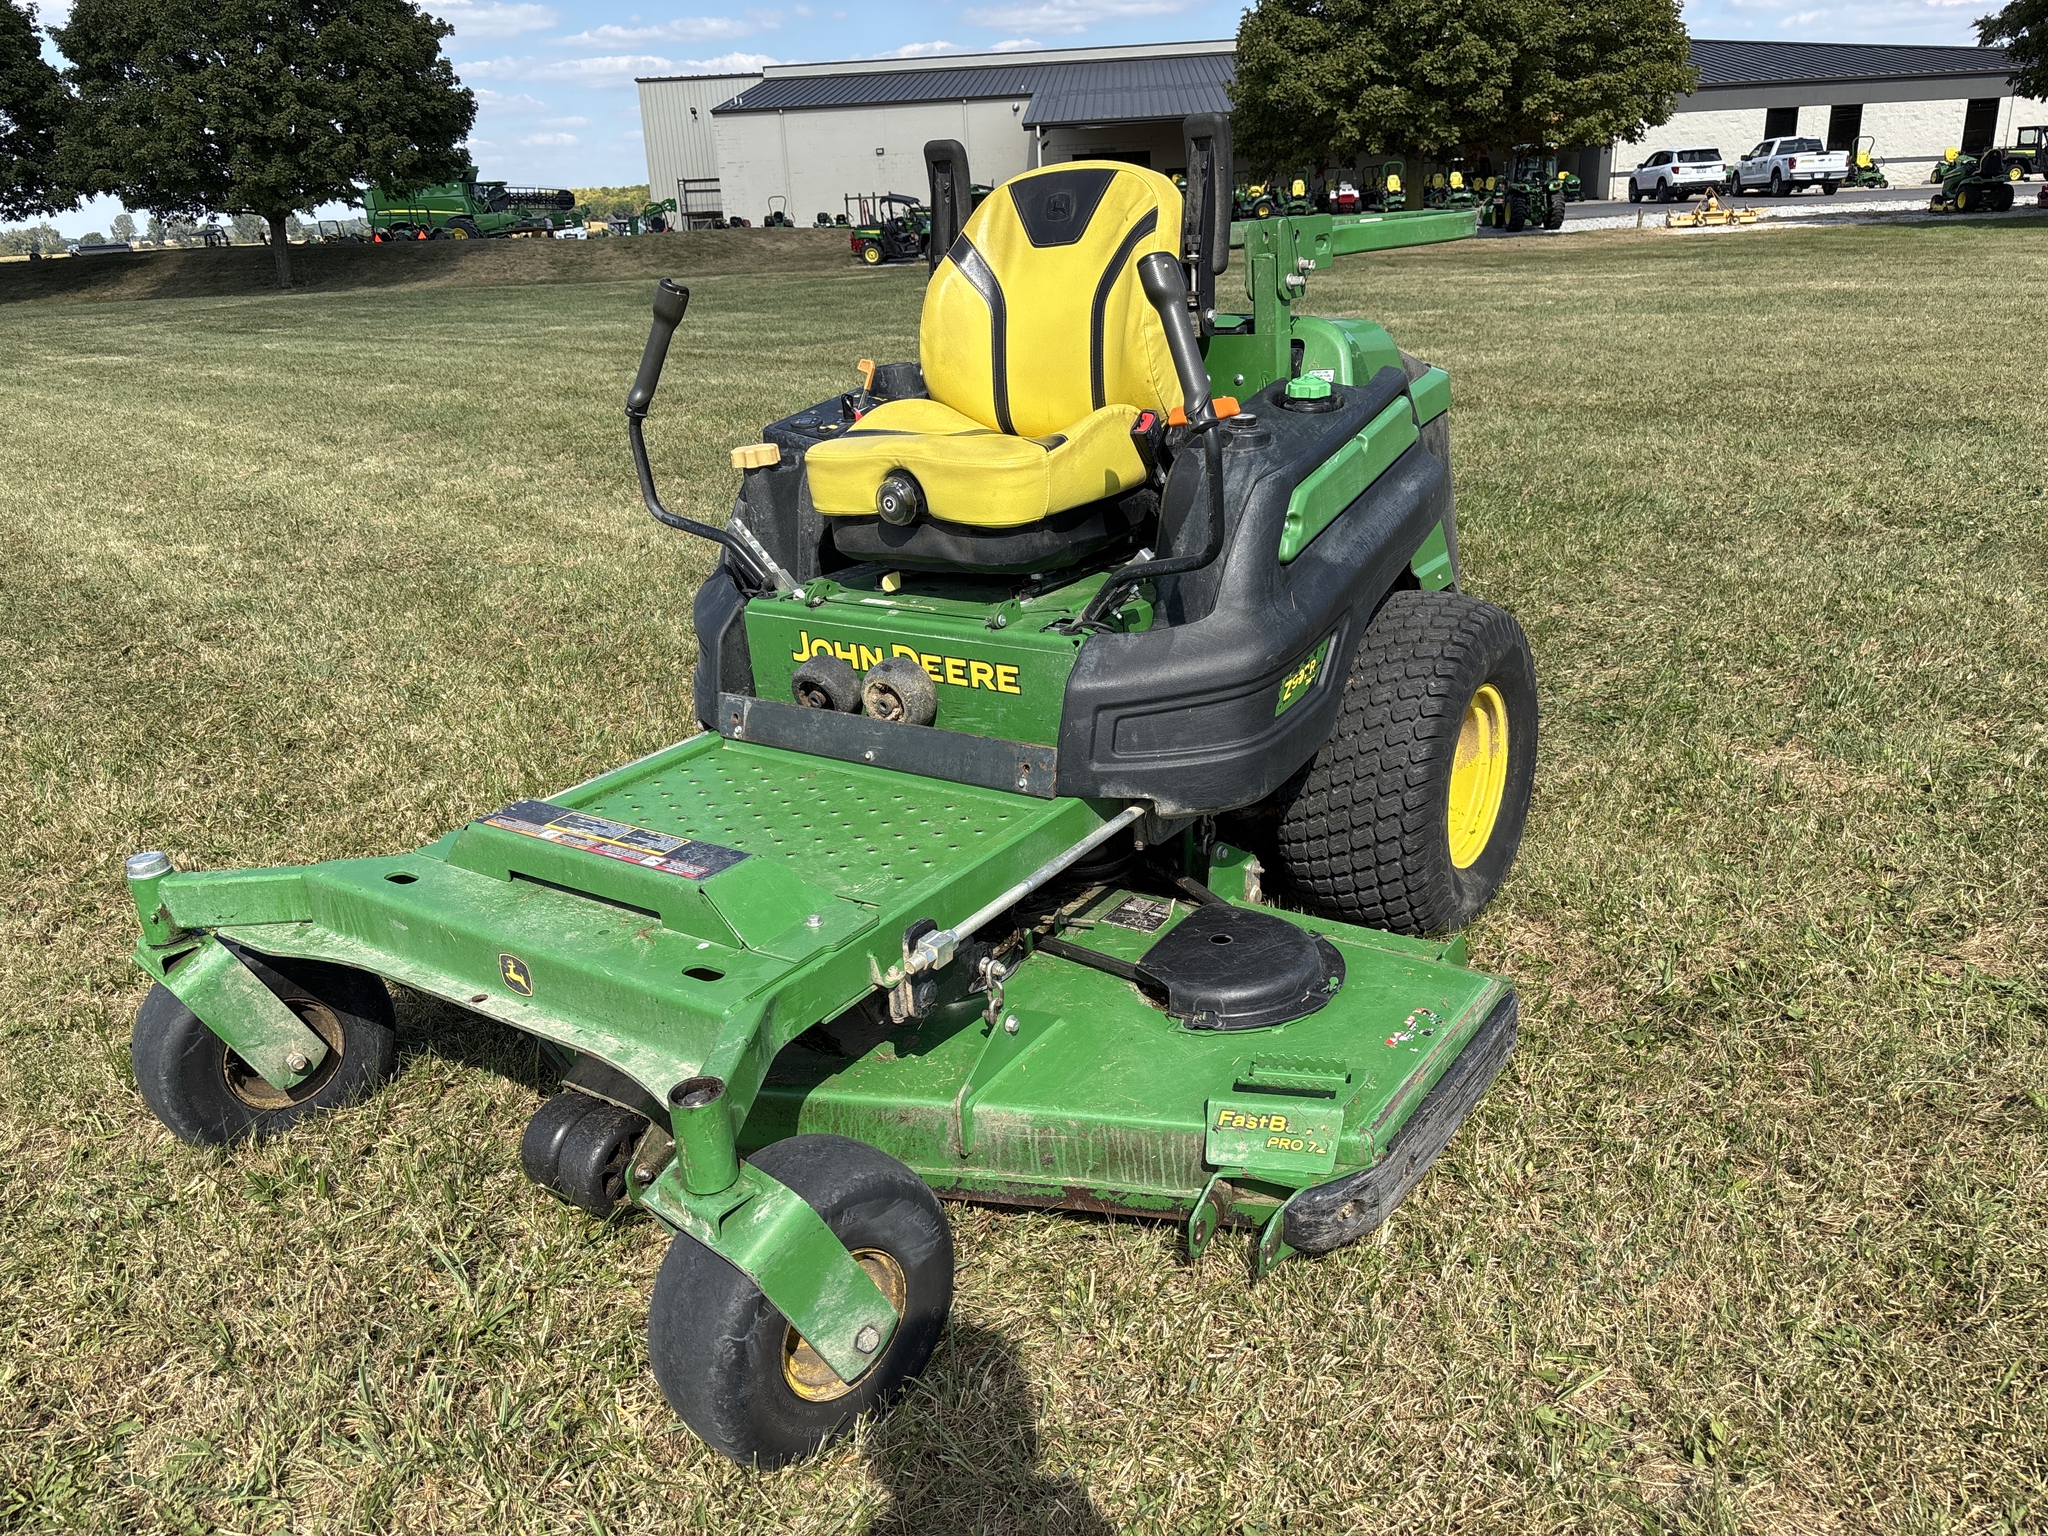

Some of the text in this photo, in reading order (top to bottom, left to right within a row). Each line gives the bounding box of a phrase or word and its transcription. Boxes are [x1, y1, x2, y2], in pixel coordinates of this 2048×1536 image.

[792, 630, 1022, 695] JOHN DEERE
[1217, 1109, 1325, 1134] FastB
[1265, 1136, 1304, 1151] PRO
